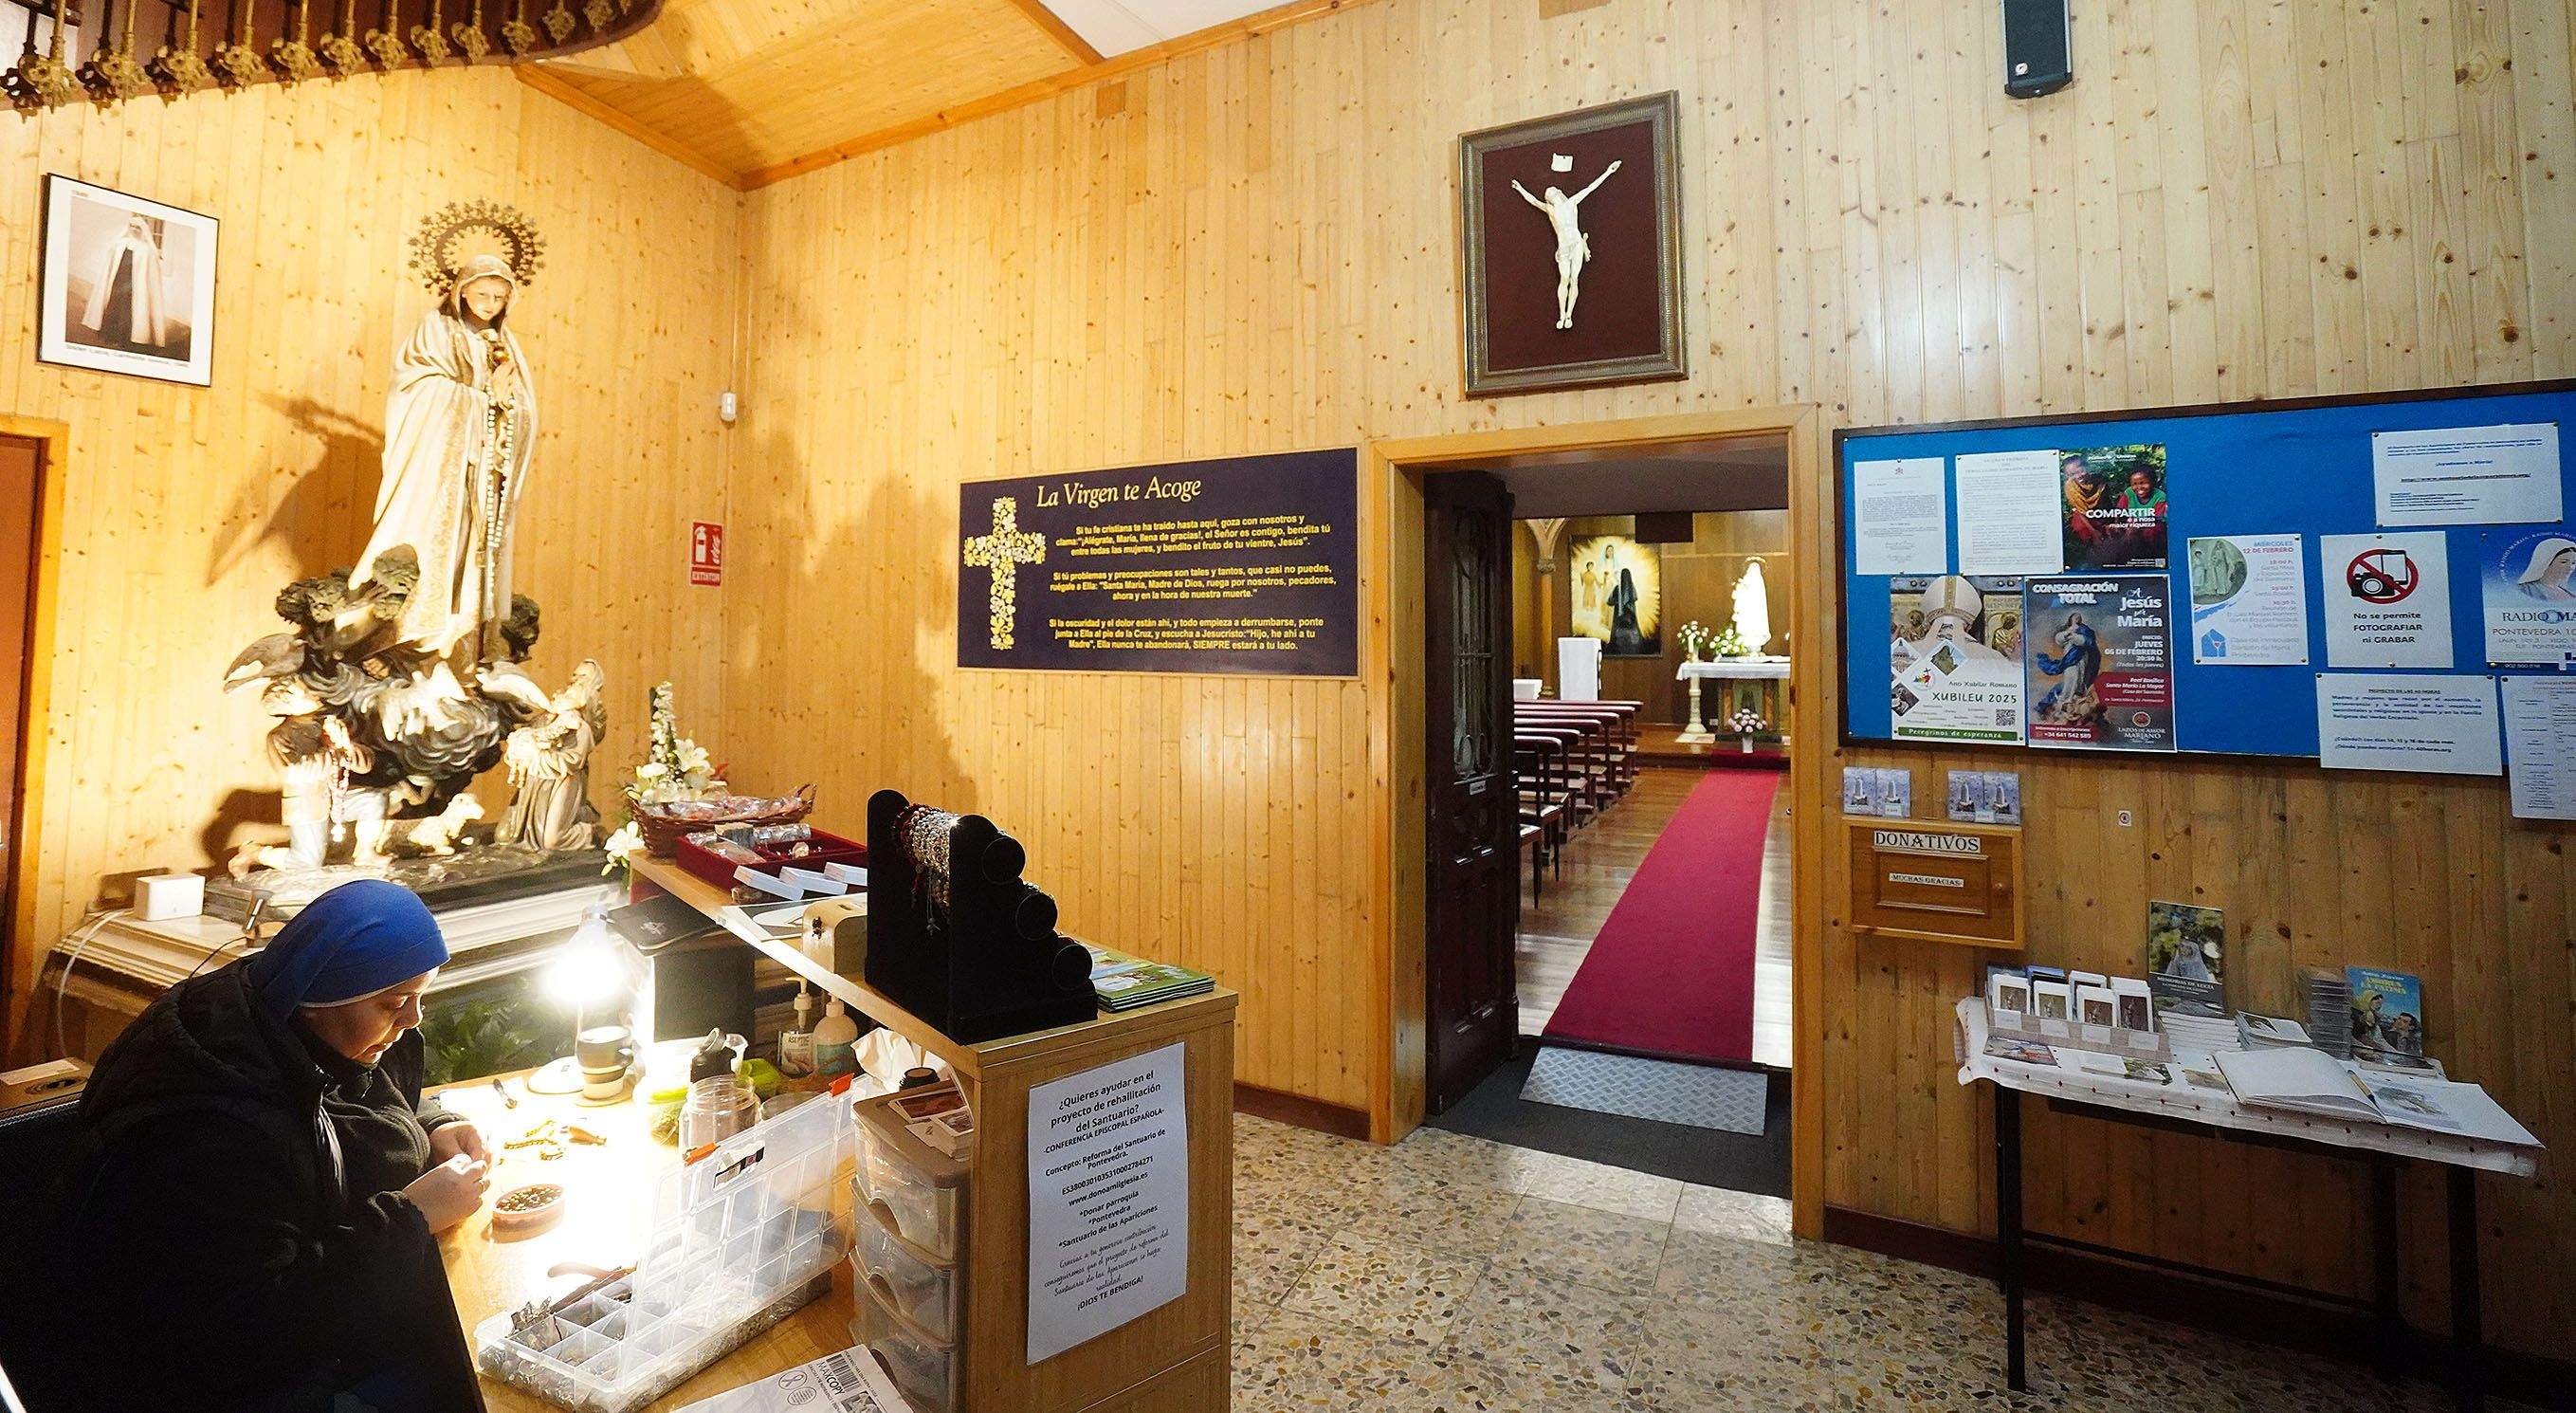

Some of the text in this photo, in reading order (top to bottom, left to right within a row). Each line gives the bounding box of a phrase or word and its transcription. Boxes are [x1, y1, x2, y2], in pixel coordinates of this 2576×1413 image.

[1036, 476, 1201, 508] La Virgen te Acoge
[2086, 508, 2155, 518] COMPARTIR
[1200, 520, 1219, 528] aquí,
[1221, 519, 1240, 527] goza
[1215, 528, 1237, 538] Señor
[1251, 527, 1285, 538] contigo,
[1288, 525, 1319, 534] bendita
[1321, 524, 1330, 533] tú
[1163, 542, 1192, 551] bendito
[1203, 541, 1221, 550] fruto
[1235, 540, 1244, 548] tu
[1246, 539, 1276, 548] vientre,
[1070, 572, 1106, 581] problemas
[1114, 570, 1173, 579] preocupaciones
[1218, 567, 1245, 576] tantos,
[1248, 567, 1263, 576] que
[1265, 565, 1282, 574] casi
[1298, 564, 1331, 575] puedes,
[1149, 579, 1172, 588] Madre
[1185, 579, 1204, 588] Dios,
[1248, 577, 1286, 585] nosotros,
[1288, 576, 1336, 586] pecadores,
[2033, 581, 2119, 593] CONSAGRACIÓN
[1113, 592, 1133, 600] ahora
[1192, 590, 1220, 598] nuestra
[1223, 589, 1257, 597] muerte."
[2058, 594, 2097, 604] TOTAL
[2120, 596, 2162, 611] Jesús
[1199, 618, 1232, 627] empieza
[1241, 618, 1296, 627] derrumbarse,
[1299, 618, 1324, 627] ponte
[2117, 615, 2163, 627] María
[2502, 612, 2549, 622] RADIO
[1103, 630, 1113, 638] pie
[1134, 630, 1154, 638] Cruz,
[1194, 640, 1230, 649] SIEMPRE
[1233, 640, 1257, 649] estará
[1278, 641, 1298, 650] lado.
[1933, 692, 2017, 703] XUBILEU 2025
[1909, 728, 1948, 737] Peregrinos
[1875, 832, 1980, 852] DONATIVOS
[1059, 1070, 1154, 1110] ¿Quieres ayudar en el
[1051, 1108, 1091, 1129] proyecto
[1094, 1102, 1105, 1111] de
[1076, 1105, 1139, 1132] del Santuario?
[1044, 1132, 1093, 1153] -CONFERENCIA
[1095, 1120, 1129, 1137] EPISCOPAL
[1046, 1160, 1081, 1176] Concepto:
[1083, 1148, 1112, 1164] Reforma
[1113, 1144, 1124, 1152] del
[1124, 1133, 1156, 1148] Santuario
[1087, 1151, 1128, 1169] Pontevedra.
[1105, 1191, 1139, 1210] parroquia
[1120, 1205, 1158, 1224] Apariciones
[1078, 1275, 1143, 1311] ¡DIOS TE BENDIGA!
[817, 1362, 847, 1396] MAXCOPY
